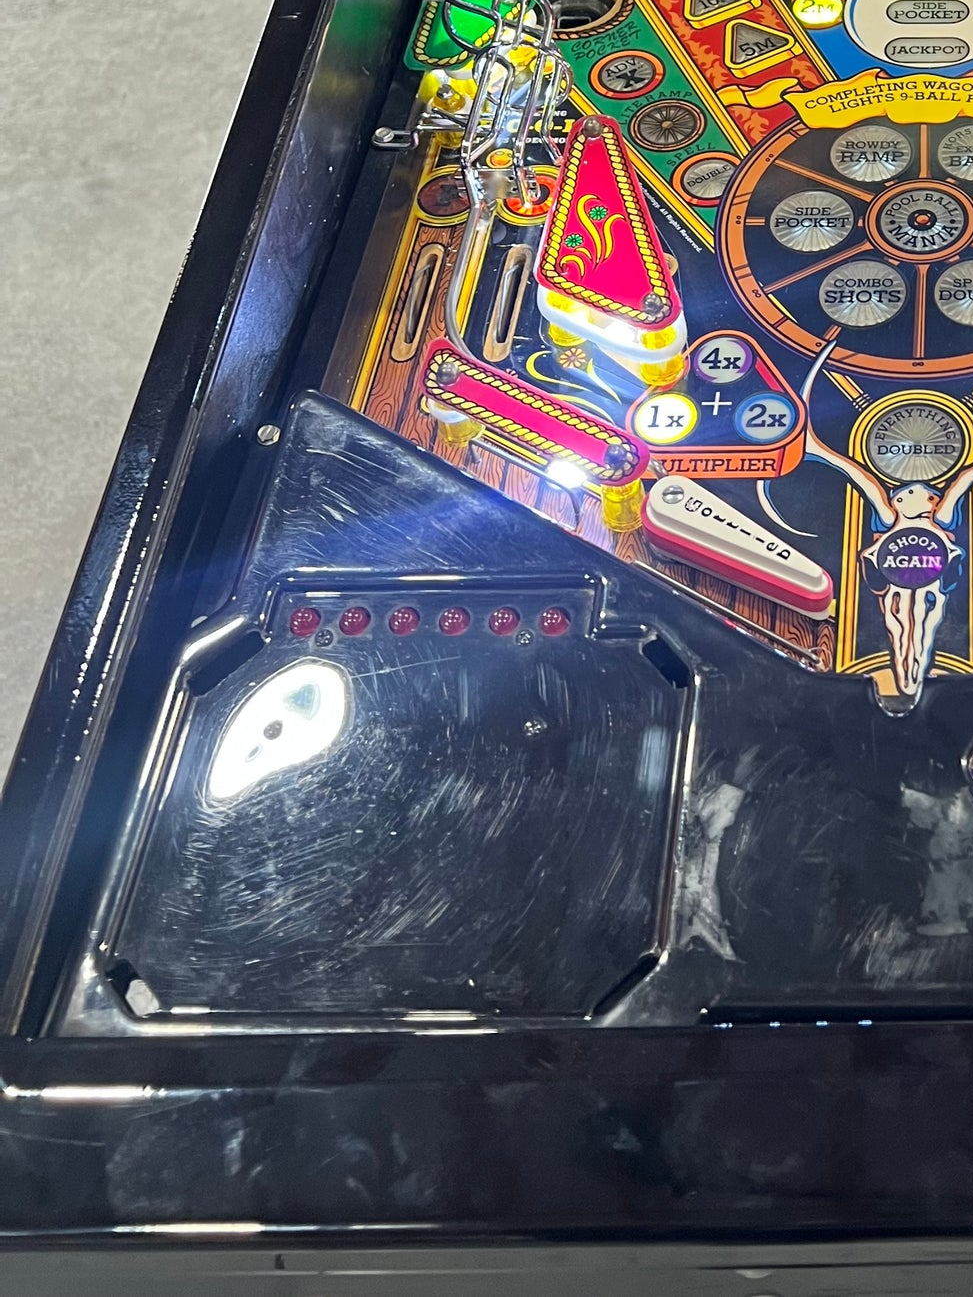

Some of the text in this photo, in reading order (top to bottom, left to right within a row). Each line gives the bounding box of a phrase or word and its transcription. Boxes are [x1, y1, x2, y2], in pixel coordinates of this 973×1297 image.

[800, 0, 835, 14] 2M
[893, 10, 965, 20] POCKET
[912, 2, 947, 11] SIDE
[570, 20, 642, 53] CORNER
[574, 29, 642, 62] POCKET
[738, 37, 777, 57] 5M
[890, 44, 966, 56] JACKPOT
[804, 81, 918, 111] COMPLETING
[829, 92, 895, 114] LIGHTS
[900, 91, 962, 102] 9-BALL
[618, 99, 644, 126] LITE
[845, 140, 900, 150] ROWDY
[665, 142, 717, 168] SPELL
[840, 151, 905, 163] RAMP
[686, 163, 731, 188] DOUBLE
[794, 206, 831, 216] SIDE
[886, 192, 957, 217] POOL BALL
[774, 217, 850, 228] POCKET
[888, 226, 960, 249] MANIA
[833, 278, 894, 288] COMBO
[824, 290, 901, 304] SHOTS
[701, 347, 742, 371] 4x
[647, 403, 788, 428] 1x 2x
[874, 407, 957, 442] EVERYTHING
[877, 444, 957, 456] DOUBLED
[662, 458, 777, 473] ULTIPLIER
[888, 534, 939, 553] SHOOT
[883, 556, 943, 569] AGAIN
